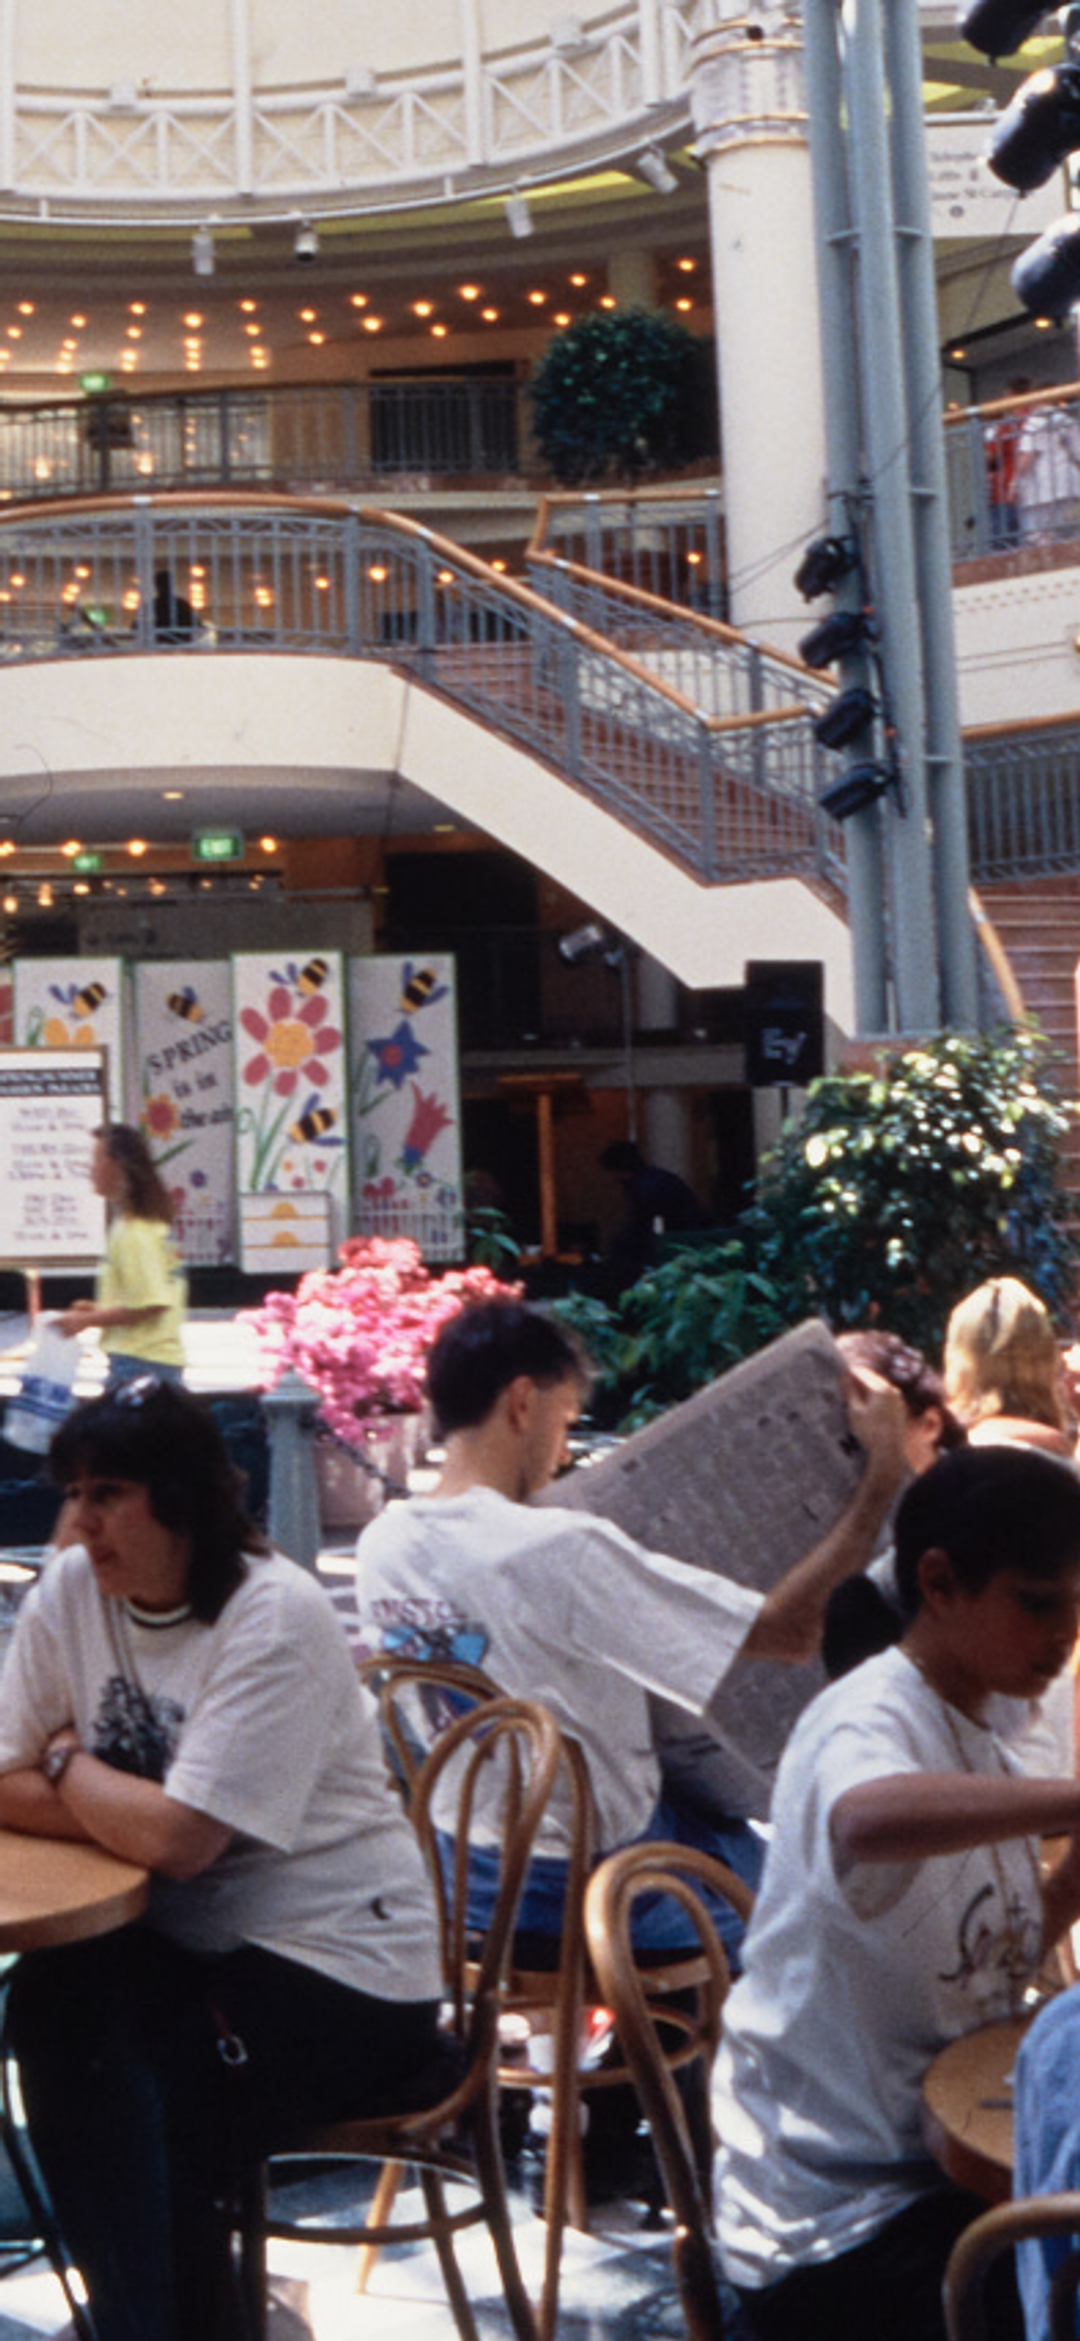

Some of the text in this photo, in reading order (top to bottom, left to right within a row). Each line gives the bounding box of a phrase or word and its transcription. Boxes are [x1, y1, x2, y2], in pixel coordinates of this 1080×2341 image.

[147, 1020, 233, 1075] SPRING
[172, 1069, 218, 1100] is in
[180, 1107, 207, 1129] the
